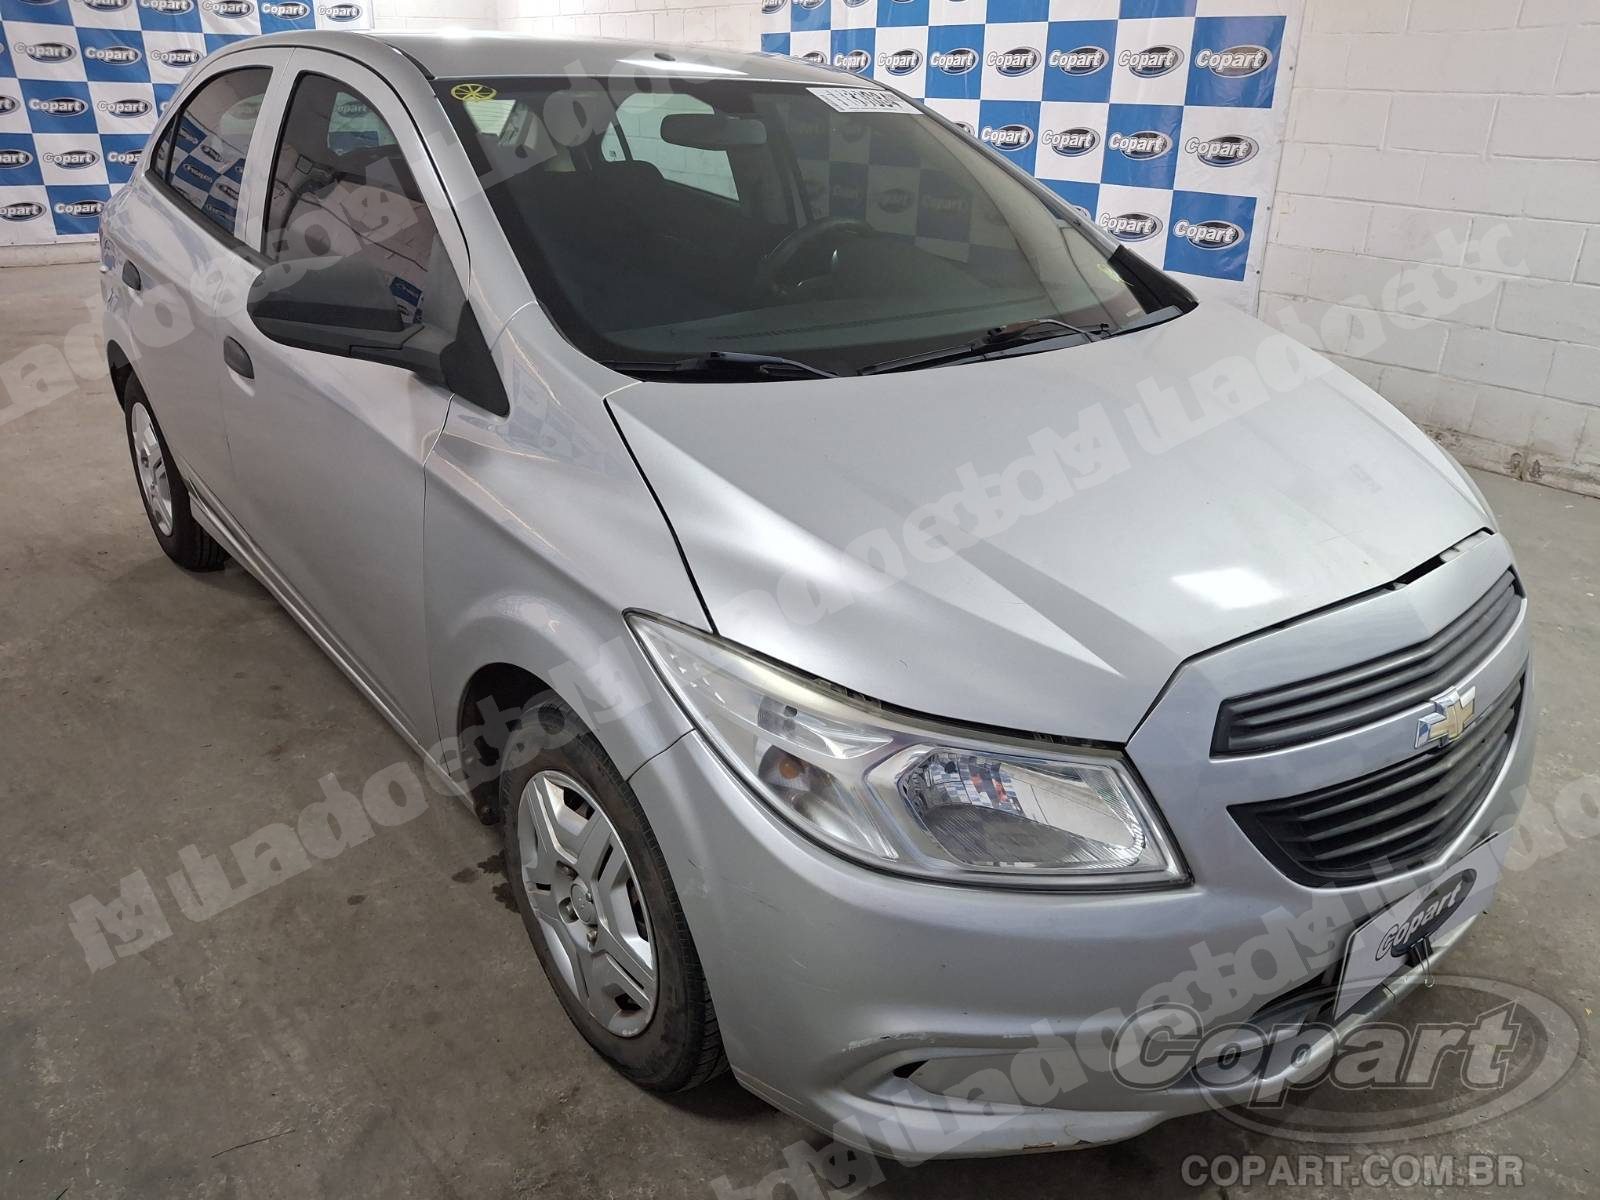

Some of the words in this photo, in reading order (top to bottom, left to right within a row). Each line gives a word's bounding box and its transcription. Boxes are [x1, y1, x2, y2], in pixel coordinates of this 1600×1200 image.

[203, 0, 248, 14] Copart
[262, 3, 304, 16] Copart
[319, 7, 358, 18] Copart
[14, 42, 68, 59] Copart
[85, 47, 136, 60] Copart
[151, 50, 197, 63] Copart
[834, 53, 866, 69] Copart
[878, 53, 917, 69] Copart
[930, 52, 973, 67] Copart
[987, 51, 1034, 68] Copart
[1049, 50, 1103, 70] Copart
[1118, 50, 1175, 70] Copart
[1195, 49, 1264, 72] Copart
[29, 99, 81, 113] Copart
[97, 101, 145, 114] Copart
[981, 126, 1028, 144] Copart
[1041, 130, 1092, 150] Copart
[1108, 132, 1164, 153] Copart
[1185, 137, 1247, 159] Copart
[43, 152, 92, 165] Copart
[108, 151, 141, 164] Copa
[0, 203, 38, 217] opart
[55, 203, 102, 215] Copart
[1099, 213, 1154, 233] Copart
[1173, 219, 1236, 244] Copart
[1375, 880, 1463, 961] Copart
